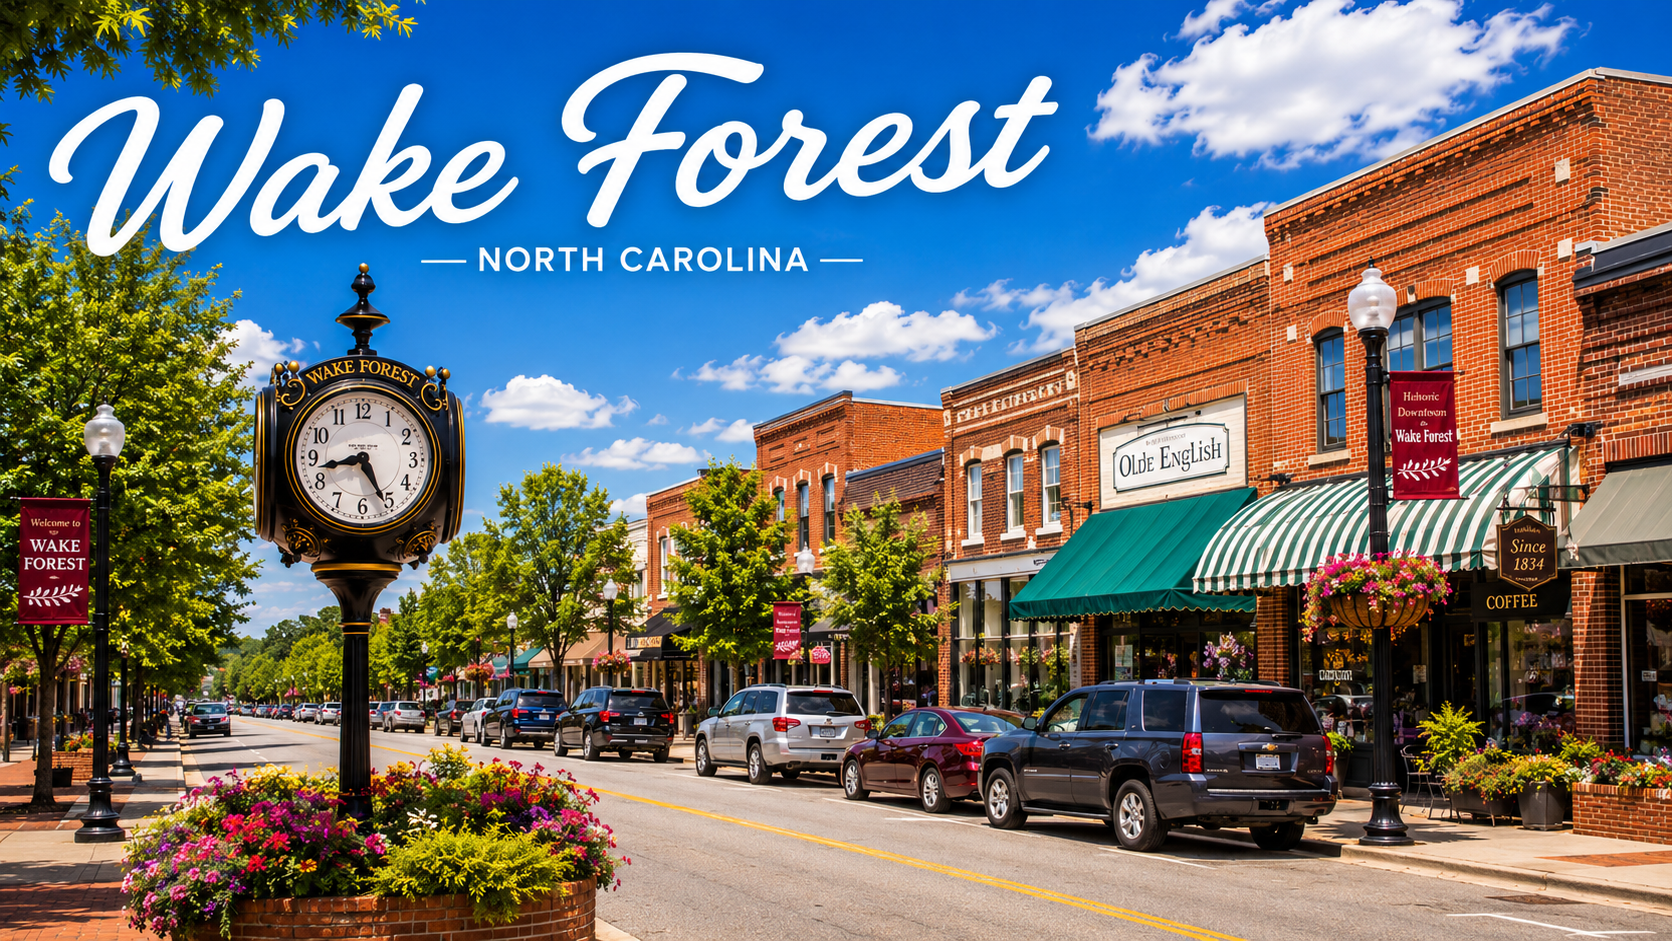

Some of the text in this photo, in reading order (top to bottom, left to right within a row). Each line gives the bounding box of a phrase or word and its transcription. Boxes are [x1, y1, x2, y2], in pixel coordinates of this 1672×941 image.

[306, 359, 420, 388] WAKE FOREST
[333, 408, 345, 425] 11
[355, 402, 371, 420] 12
[385, 410, 391, 427] 1
[313, 427, 329, 444] 10
[401, 428, 411, 446] 2
[1395, 429, 1453, 443] Wake Forest
[308, 449, 318, 467] 9
[408, 451, 418, 469] 3
[314, 472, 325, 490] 8
[400, 474, 411, 491] 4
[332, 492, 342, 509] 7
[357, 498, 367, 515] 6
[384, 492, 394, 509] 5
[72, 519, 81, 528] to
[30, 539, 81, 553] WAKE
[1510, 538, 1546, 554] Since
[24, 557, 86, 571] FOREST
[1513, 557, 1545, 571] 1834
[1486, 593, 1538, 610] COFFEE
